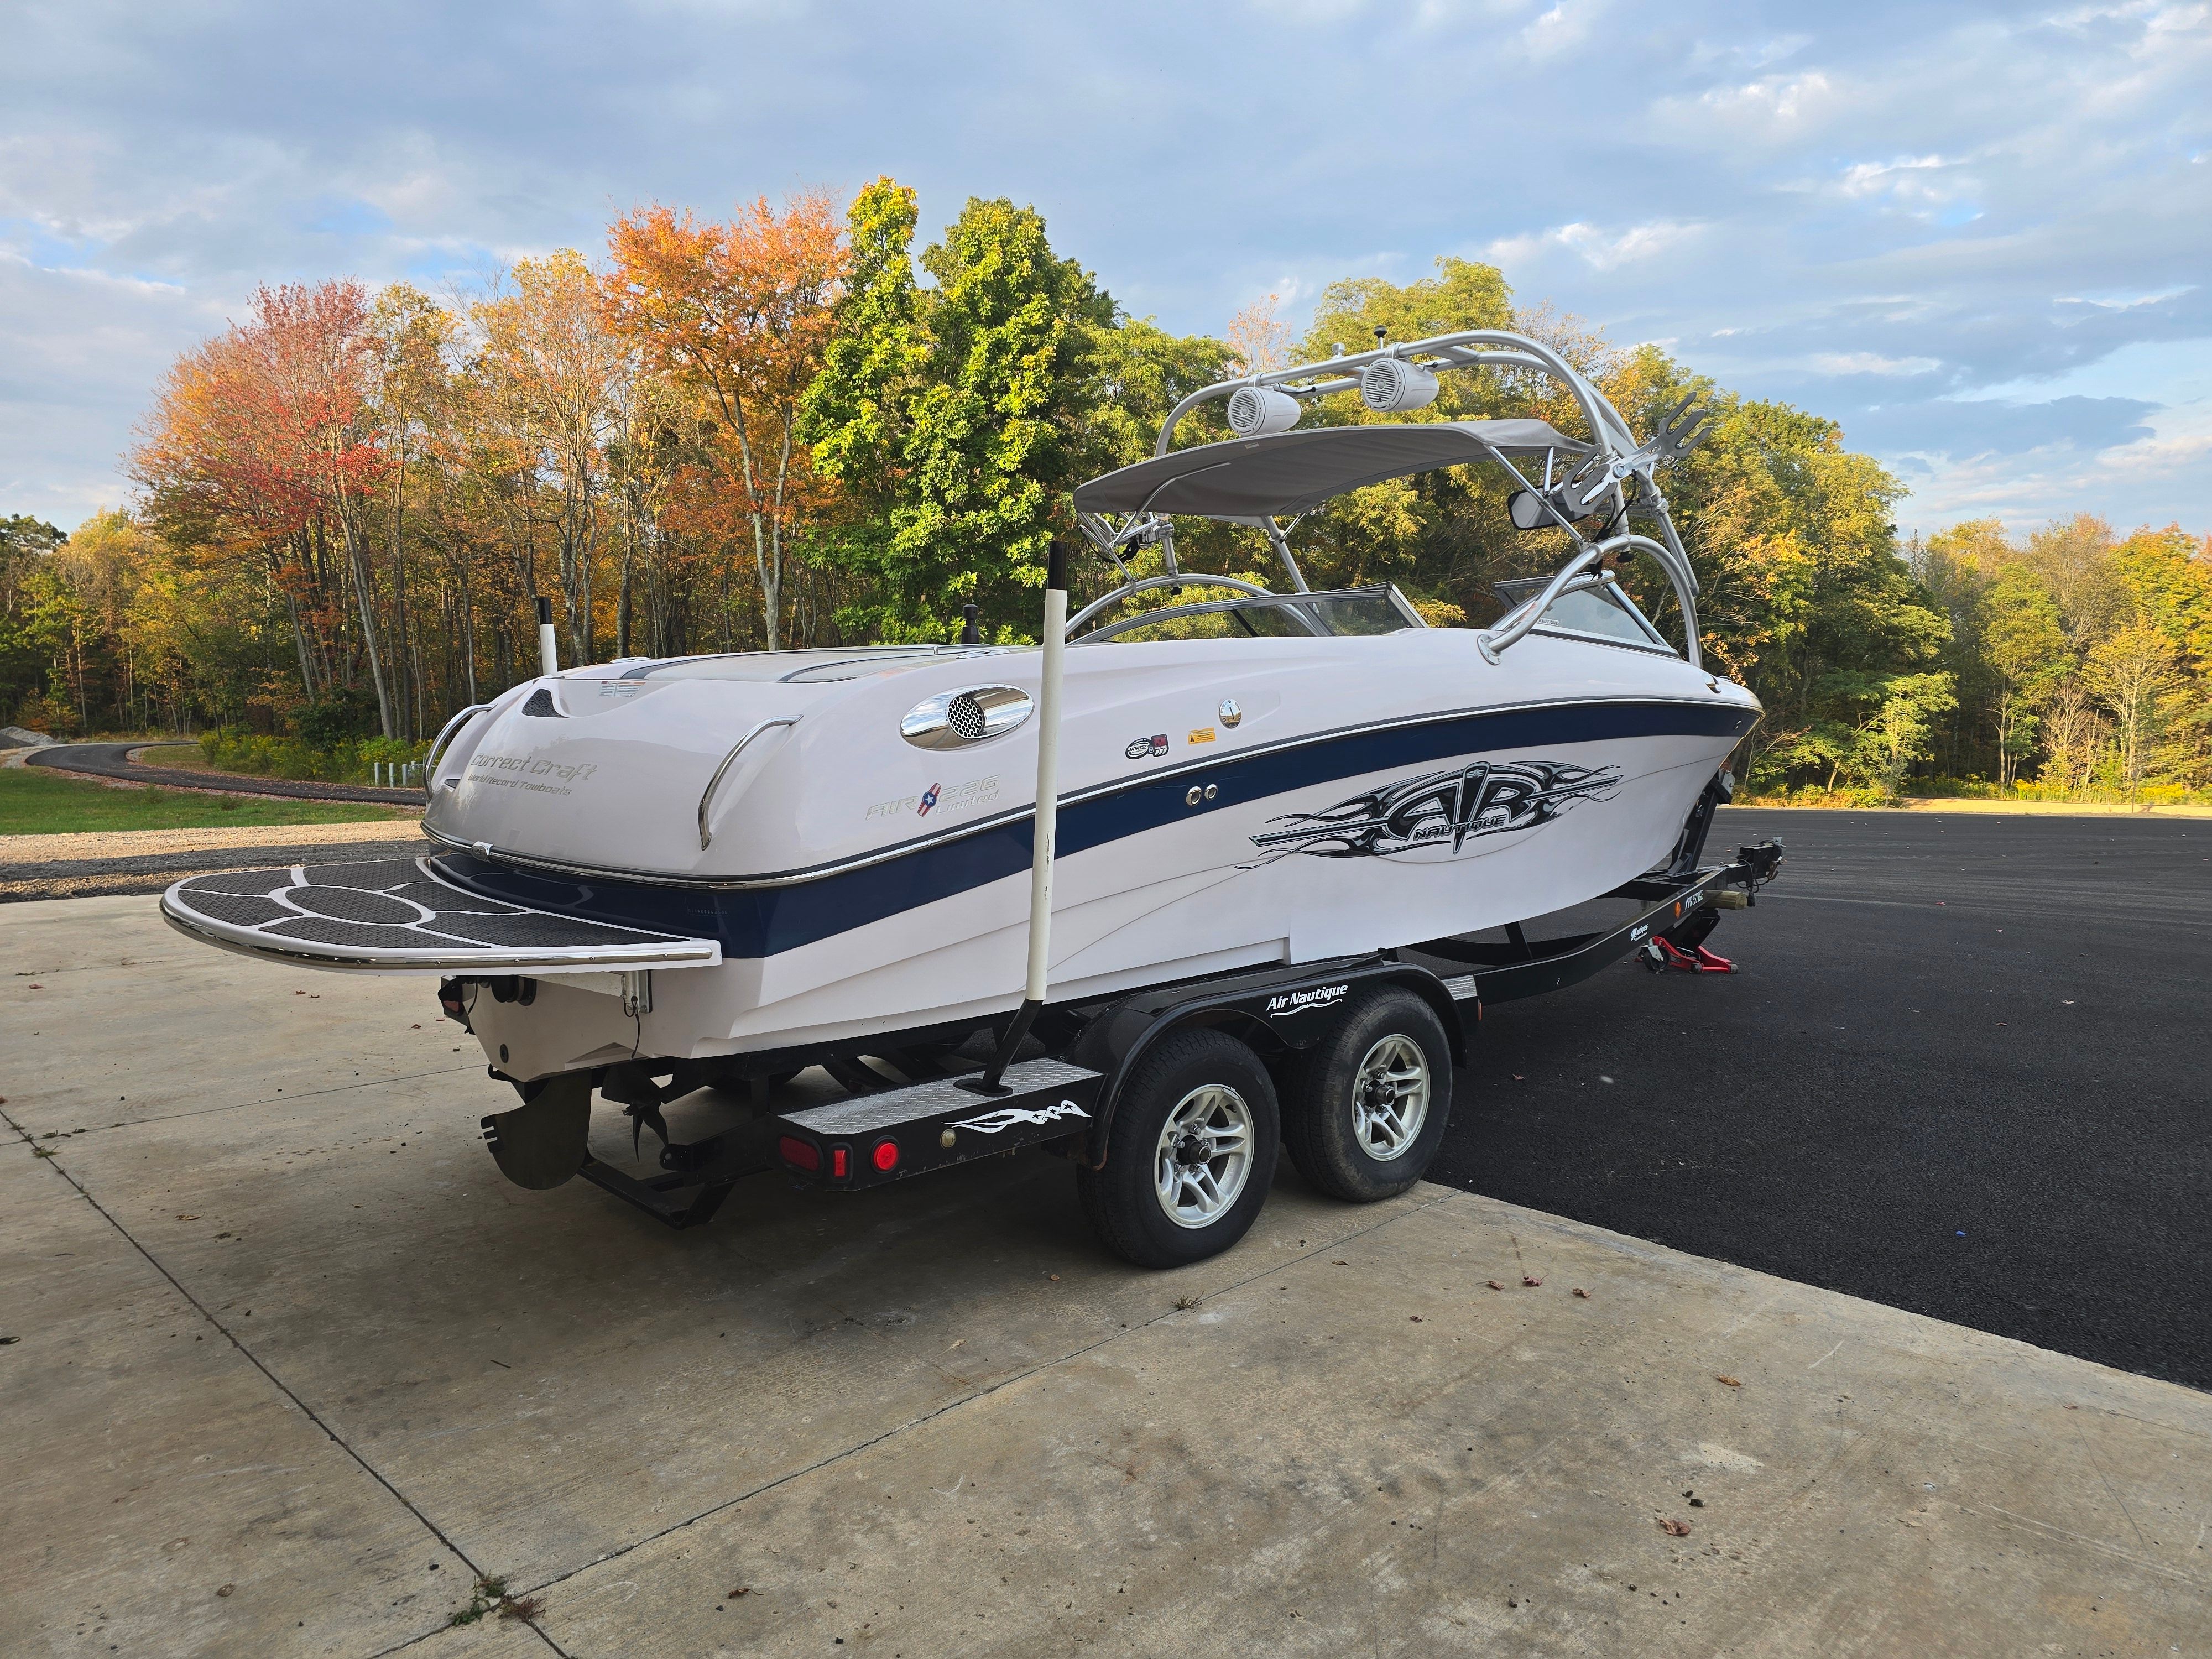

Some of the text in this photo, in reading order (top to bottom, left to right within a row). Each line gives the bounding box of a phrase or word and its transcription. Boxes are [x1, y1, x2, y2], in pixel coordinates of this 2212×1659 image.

[470, 752, 598, 784] Correct Craft
[468, 774, 573, 796] World Record Towboats
[865, 774, 1001, 821] AIR 226
[935, 789, 1000, 816] Limited
[1412, 813, 1508, 842] NAUTIQUE
[1266, 984, 1348, 1011] Air Nautique
